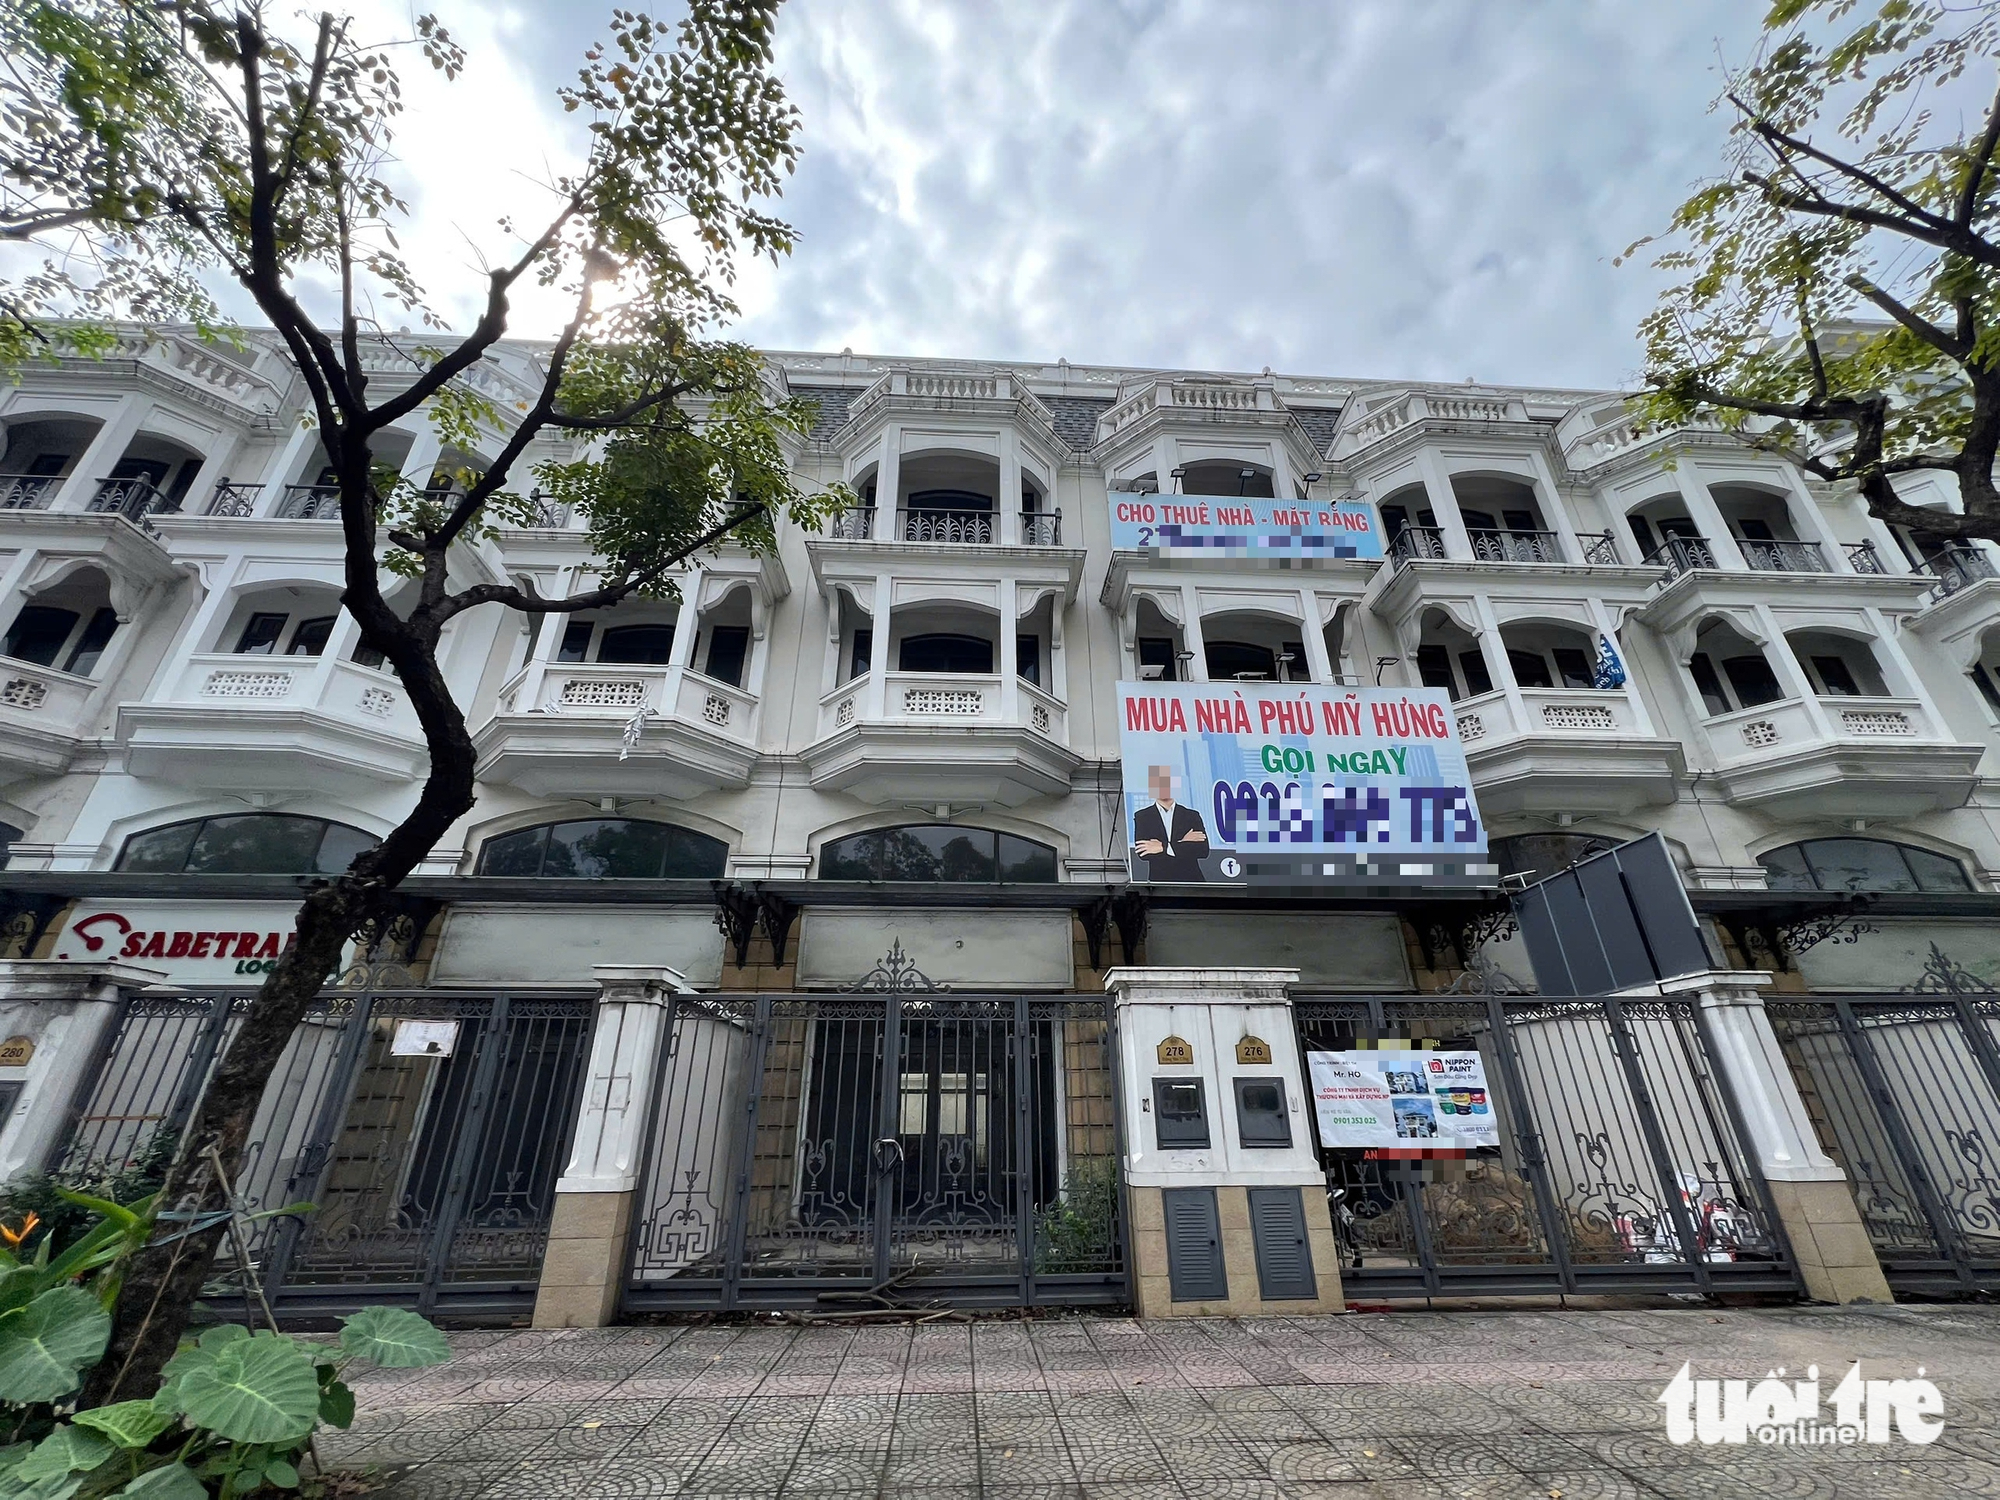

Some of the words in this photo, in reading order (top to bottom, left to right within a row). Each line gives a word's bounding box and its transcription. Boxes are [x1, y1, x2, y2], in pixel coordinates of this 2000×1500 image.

[1117, 503, 1156, 524] CHO
[1160, 501, 1211, 525] THUÊ
[1216, 503, 1256, 526] NHÀ
[1125, 697, 1187, 733] MUA
[1194, 690, 1253, 734] NHÀ
[1258, 691, 1316, 737] PHÚ
[1322, 693, 1363, 736] MỸ
[1371, 696, 1450, 739] HƯNG
[1261, 744, 1315, 779] GỌI
[1329, 747, 1408, 776] NGAY
[1, 1047, 25, 1058] 280
[1165, 1046, 1185, 1057] 278
[1244, 1046, 1263, 1057] 276
[1449, 1065, 1472, 1073] PAINT
